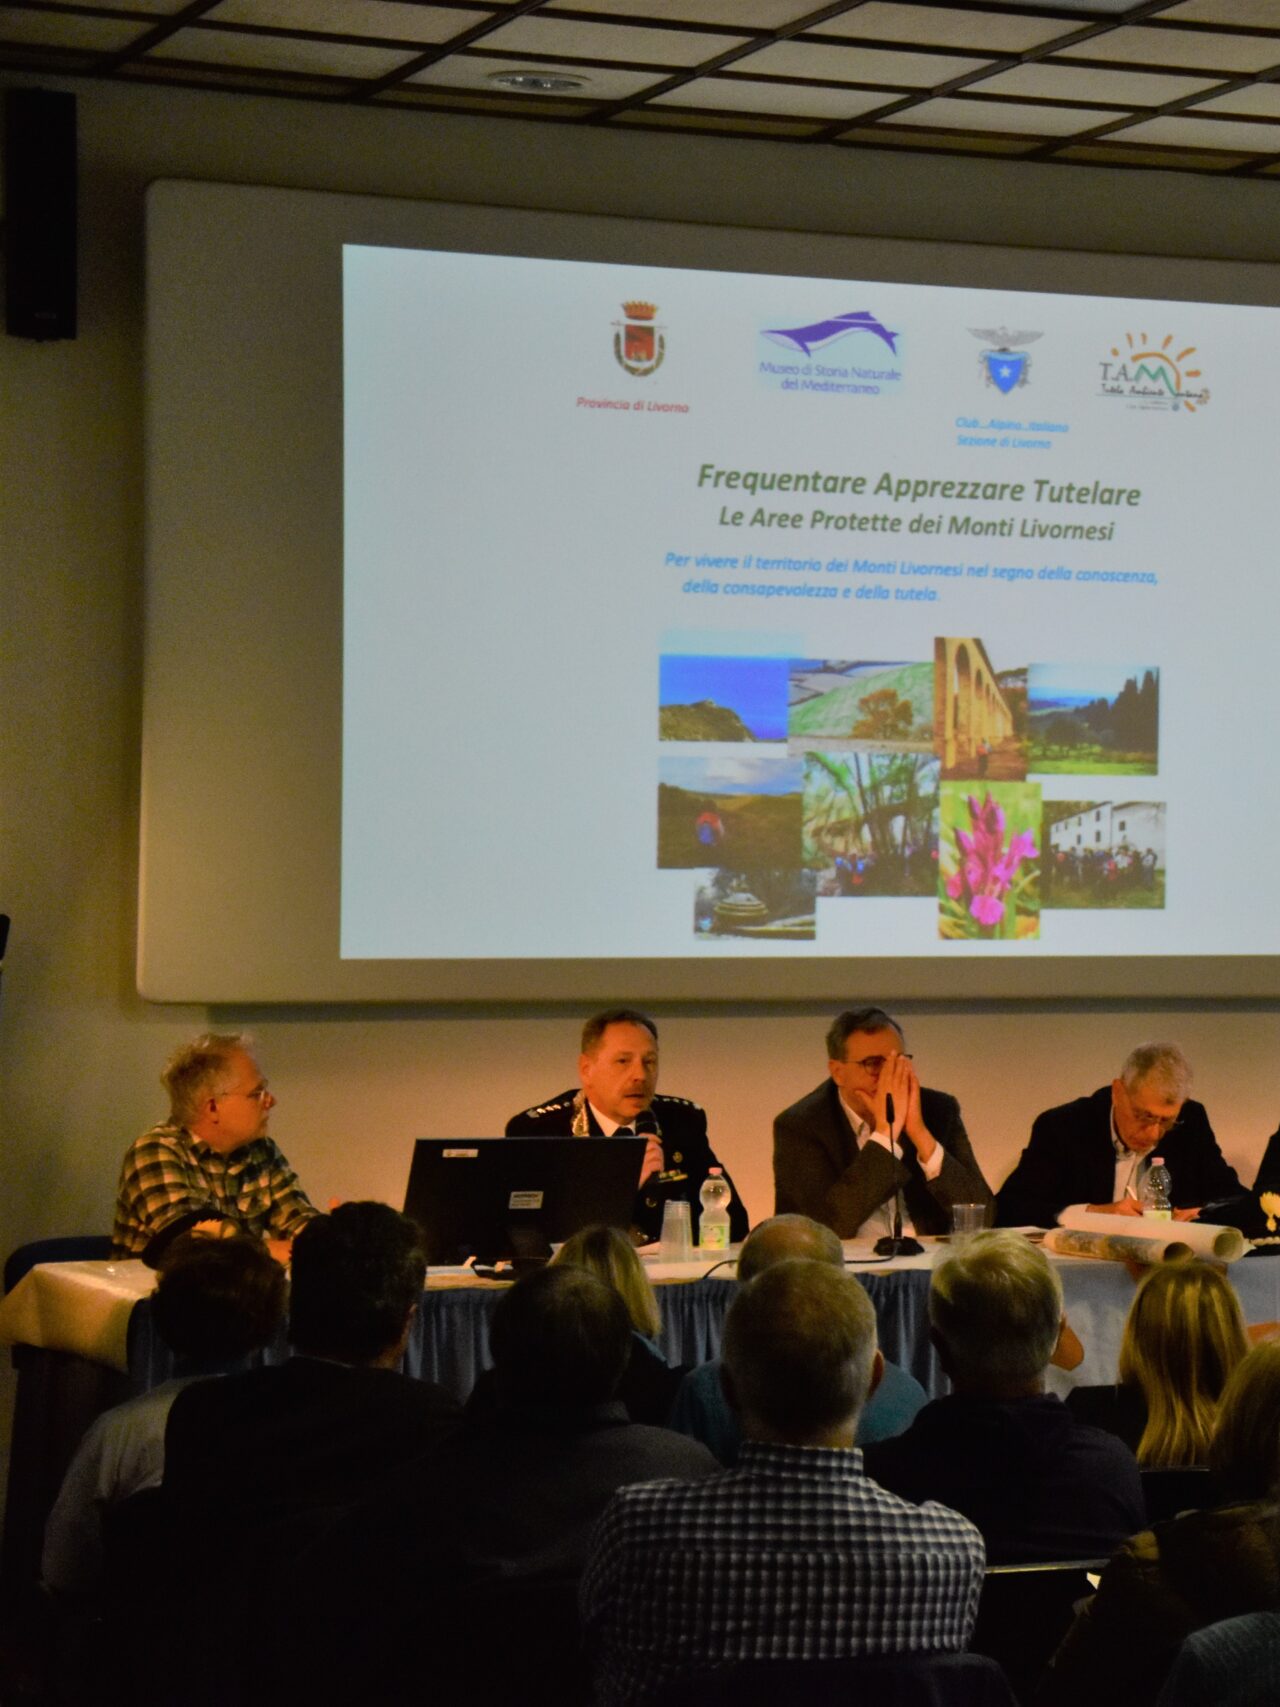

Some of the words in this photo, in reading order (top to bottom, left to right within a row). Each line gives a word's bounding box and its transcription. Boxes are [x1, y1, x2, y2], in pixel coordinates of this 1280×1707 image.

[760, 362, 801, 377] Museo
[804, 364, 815, 378] di
[816, 365, 849, 379] Storia
[852, 367, 902, 382] Naturale
[781, 377, 800, 391] del
[802, 379, 880, 395] Mediterraneo
[576, 397, 631, 410] Provincia
[633, 400, 645, 411] di
[646, 401, 690, 413] Livorno
[698, 464, 867, 495] Frequentare
[874, 472, 1025, 502] Apprezzare
[1034, 479, 1141, 506] Tutelare
[719, 506, 744, 526] Le
[749, 508, 804, 529] Aree
[810, 510, 902, 532] Protette
[908, 514, 942, 534] dei
[948, 516, 1014, 537] Monti
[1020, 519, 1115, 541] Livornesi
[665, 552, 692, 567] Per
[694, 556, 739, 568] vivere
[743, 554, 754, 569] il
[755, 557, 822, 572] territorio
[826, 559, 848, 573] dei
[852, 560, 897, 574] Monti
[900, 562, 963, 576] Livornesi
[967, 565, 990, 577] nel
[992, 567, 1033, 582] segno
[1037, 566, 1073, 581] della
[1075, 570, 1158, 586] conoscenza,
[682, 579, 720, 594] della
[722, 584, 839, 598] consapevolezza
[842, 587, 852, 598] e
[855, 585, 890, 600] della
